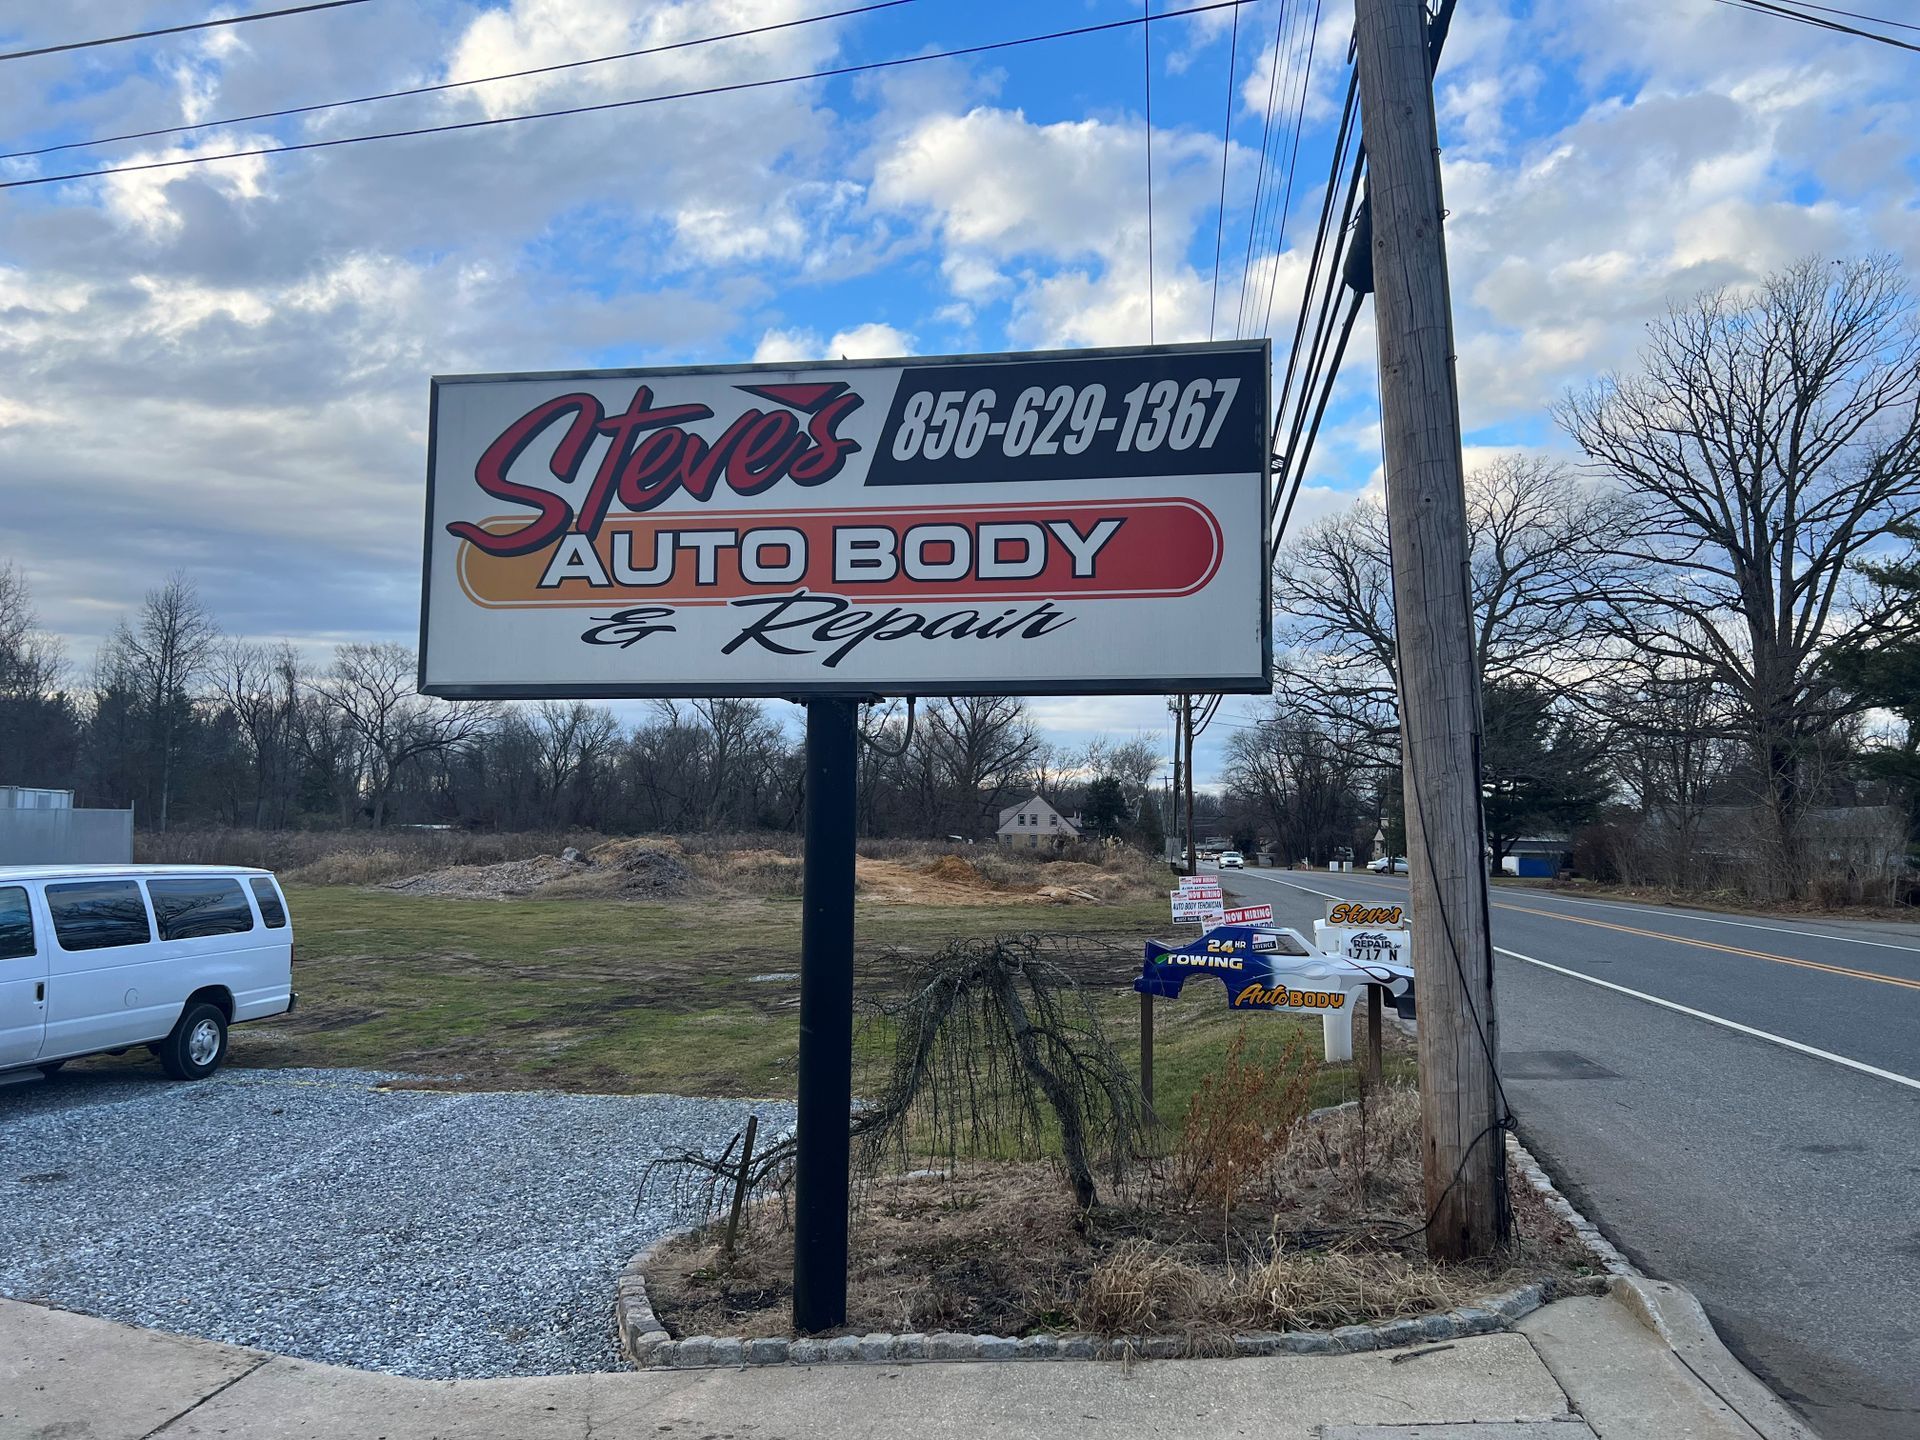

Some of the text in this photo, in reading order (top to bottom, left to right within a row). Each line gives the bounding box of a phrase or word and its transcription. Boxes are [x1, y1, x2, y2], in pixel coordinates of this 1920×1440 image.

[892, 378, 1240, 461] 856-629-1367
[446, 382, 864, 558] Steve's
[536, 517, 1127, 589] AUTO BODY
[580, 590, 1077, 668] & Repair
[1188, 890, 1201, 899] NOW
[1202, 889, 1221, 898] HIRING
[1173, 902, 1184, 911] AUTO
[1185, 902, 1196, 910] BODY
[1330, 903, 1403, 924] Steve's
[1224, 911, 1243, 922] NOW
[1244, 907, 1271, 920] HIRING
[1350, 932, 1388, 943] Auto
[1353, 940, 1392, 949] REPAIR
[1207, 939, 1247, 954] 24 HR
[1166, 954, 1243, 970] TOWING
[1348, 948, 1398, 961] 1717 N
[1234, 983, 1345, 1009] Auto BODY
